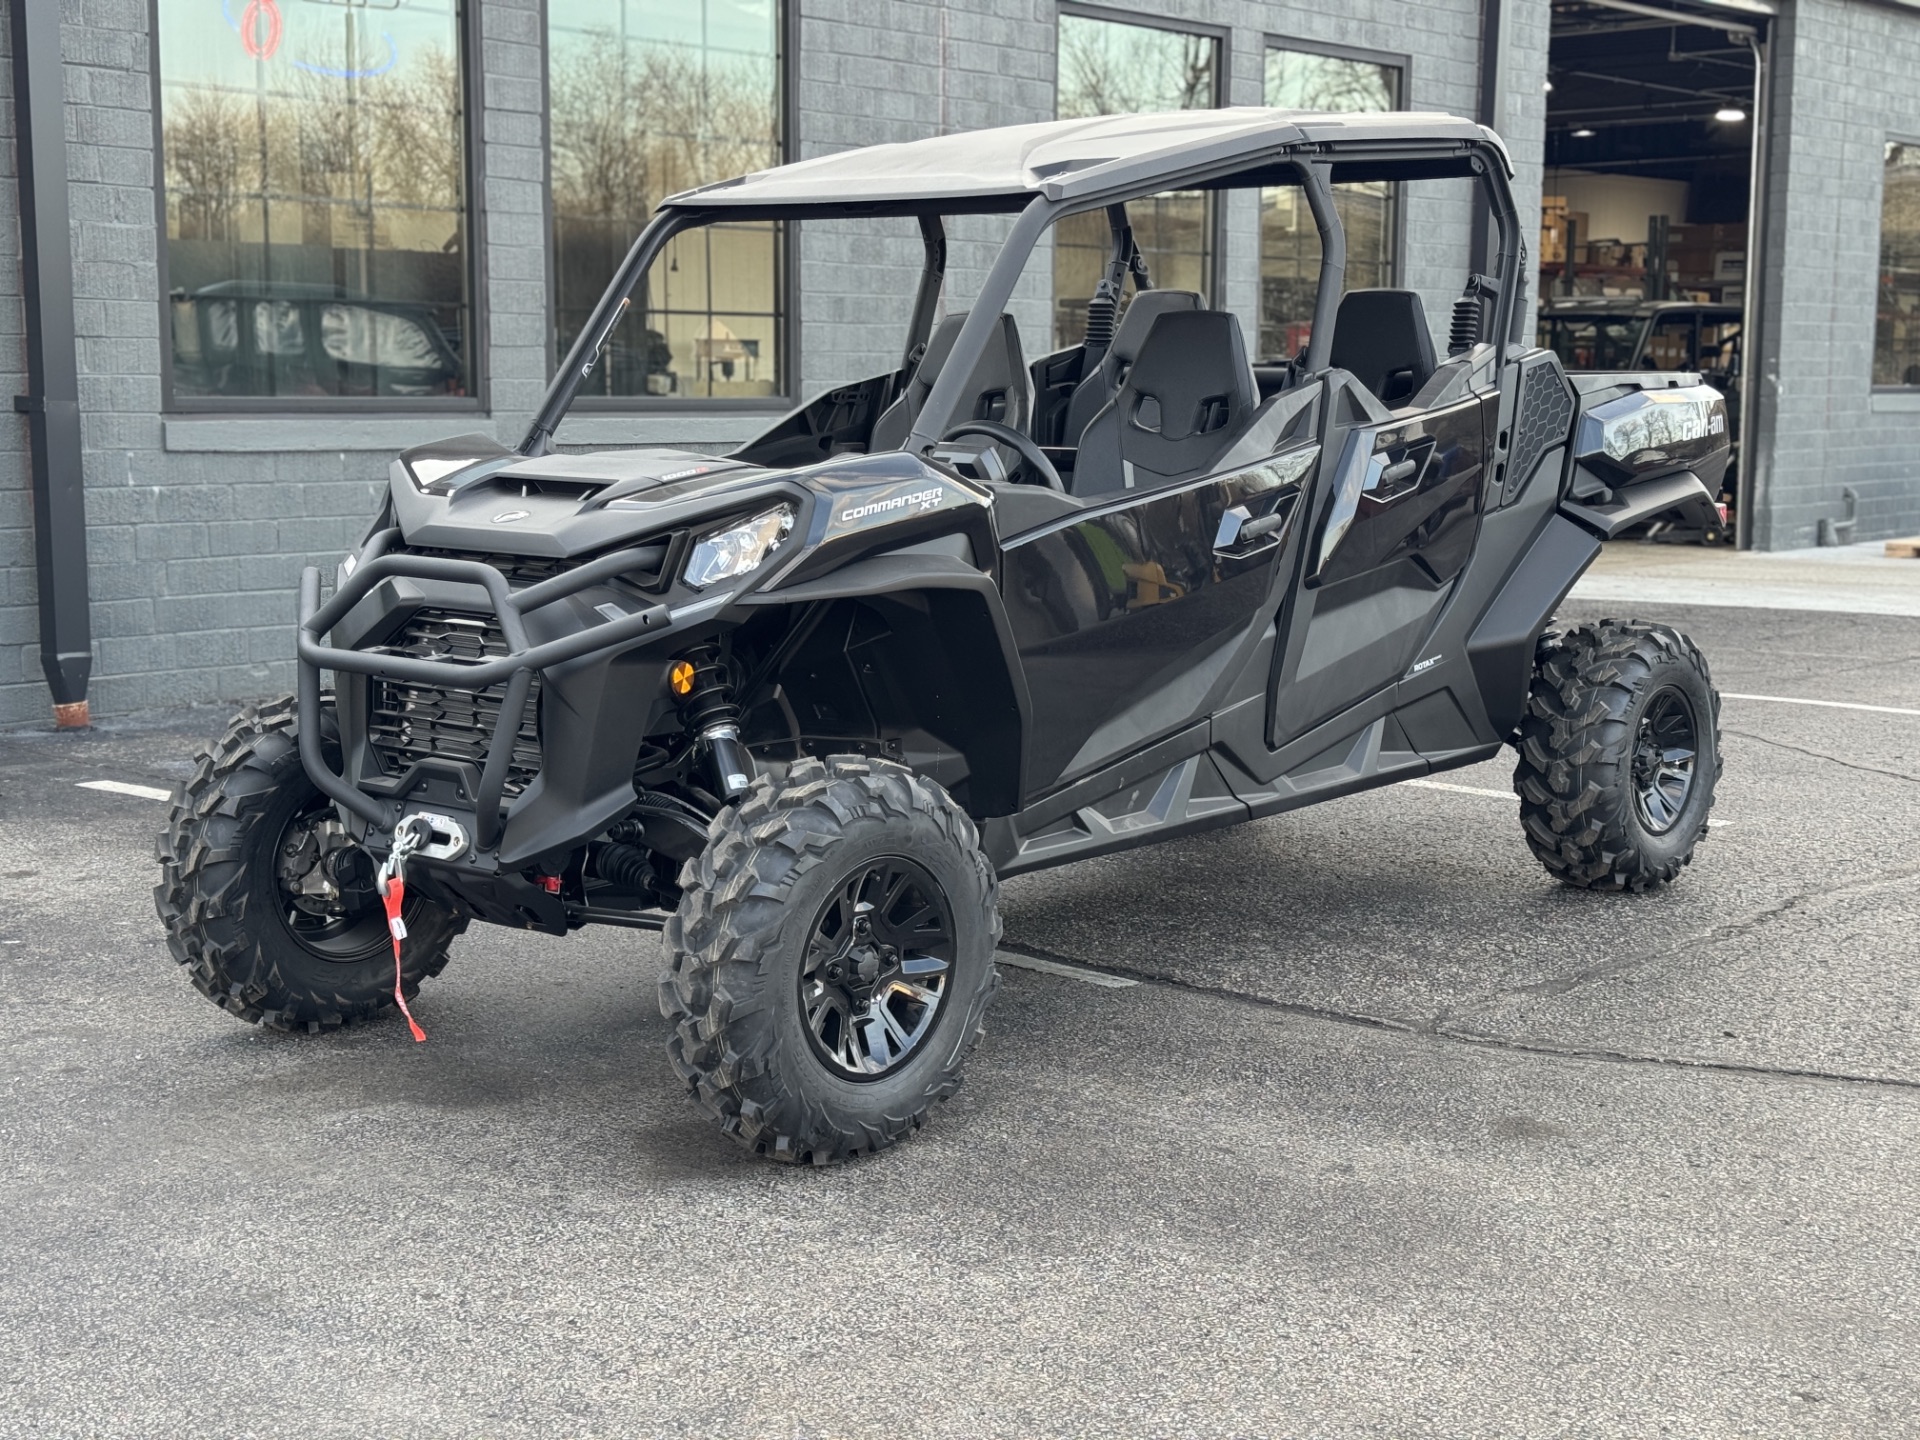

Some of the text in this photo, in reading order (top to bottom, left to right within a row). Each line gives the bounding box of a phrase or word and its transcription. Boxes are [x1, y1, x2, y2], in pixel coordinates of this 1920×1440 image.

[1682, 414, 1724, 441] can-am
[841, 487, 943, 522] COMMANDER
[919, 497, 943, 511] XT
[1413, 658, 1435, 673] ROTAX
